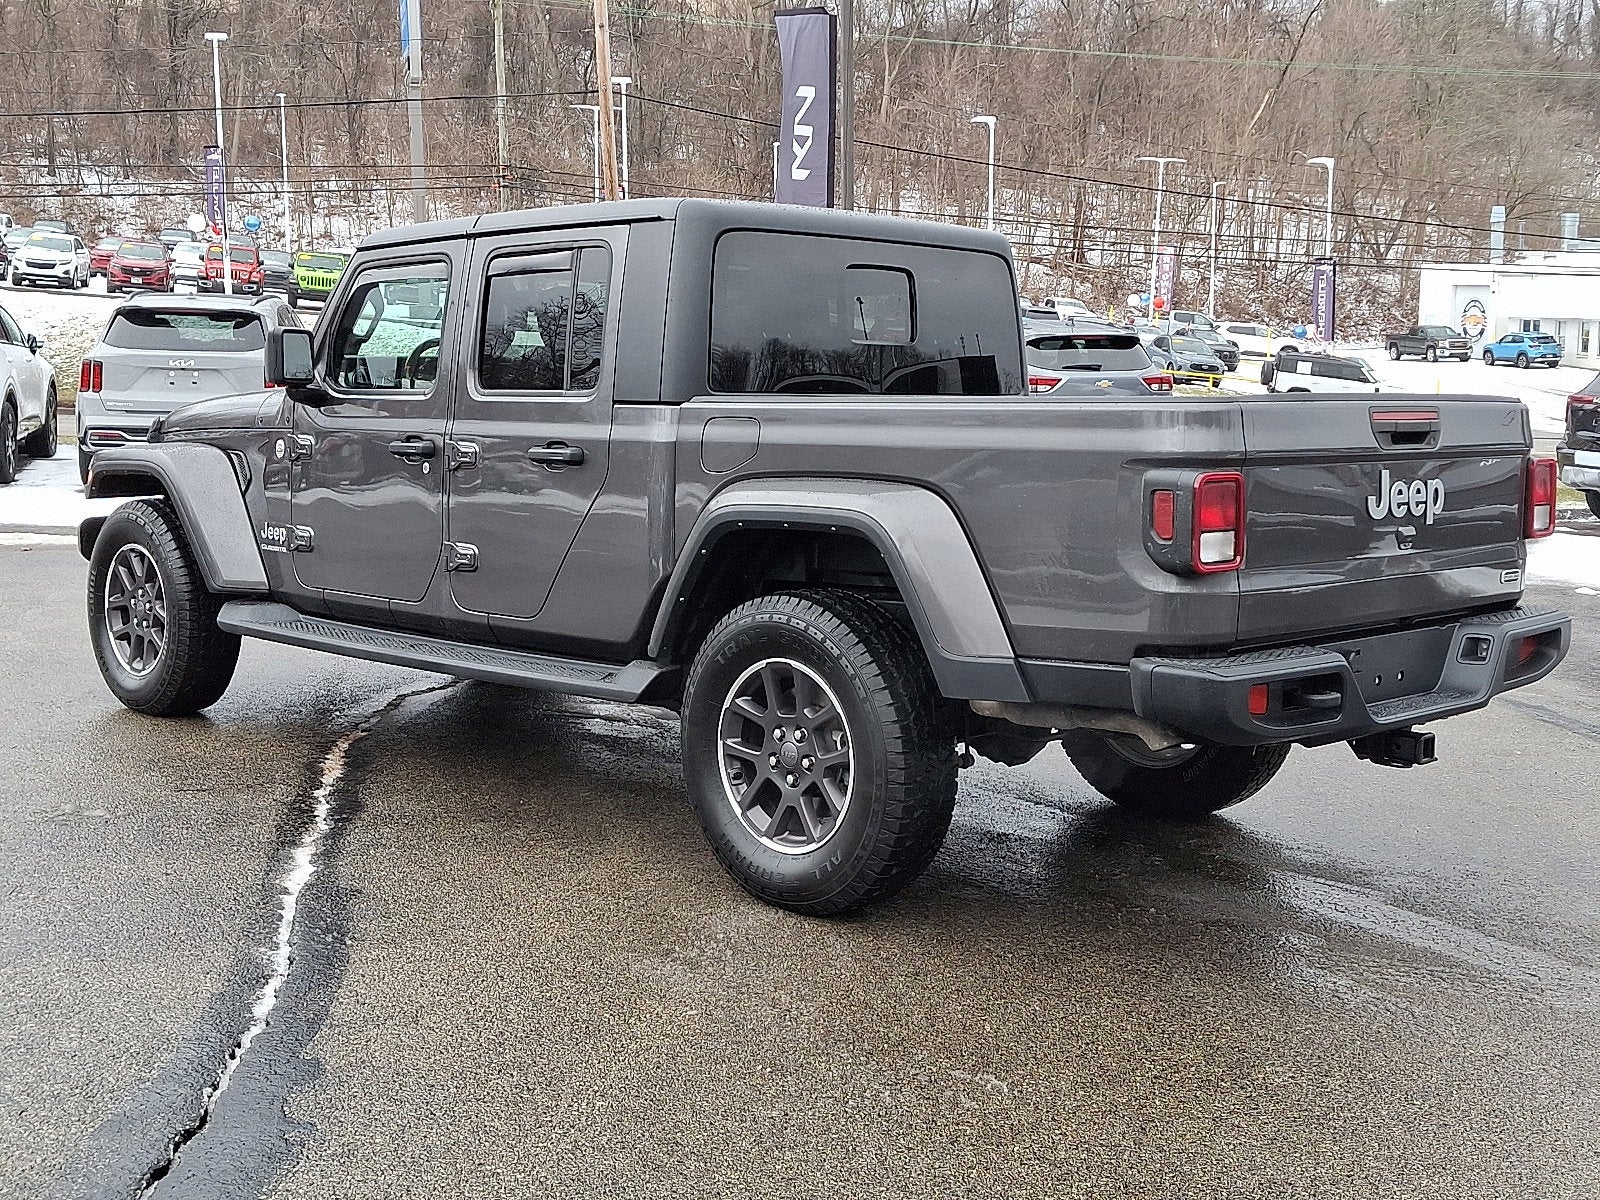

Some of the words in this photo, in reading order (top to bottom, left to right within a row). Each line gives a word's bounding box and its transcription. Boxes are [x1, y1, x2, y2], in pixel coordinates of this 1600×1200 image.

[1367, 469, 1445, 525] Jeep
[261, 521, 287, 545] Jeep
[809, 849, 842, 880] ALL
